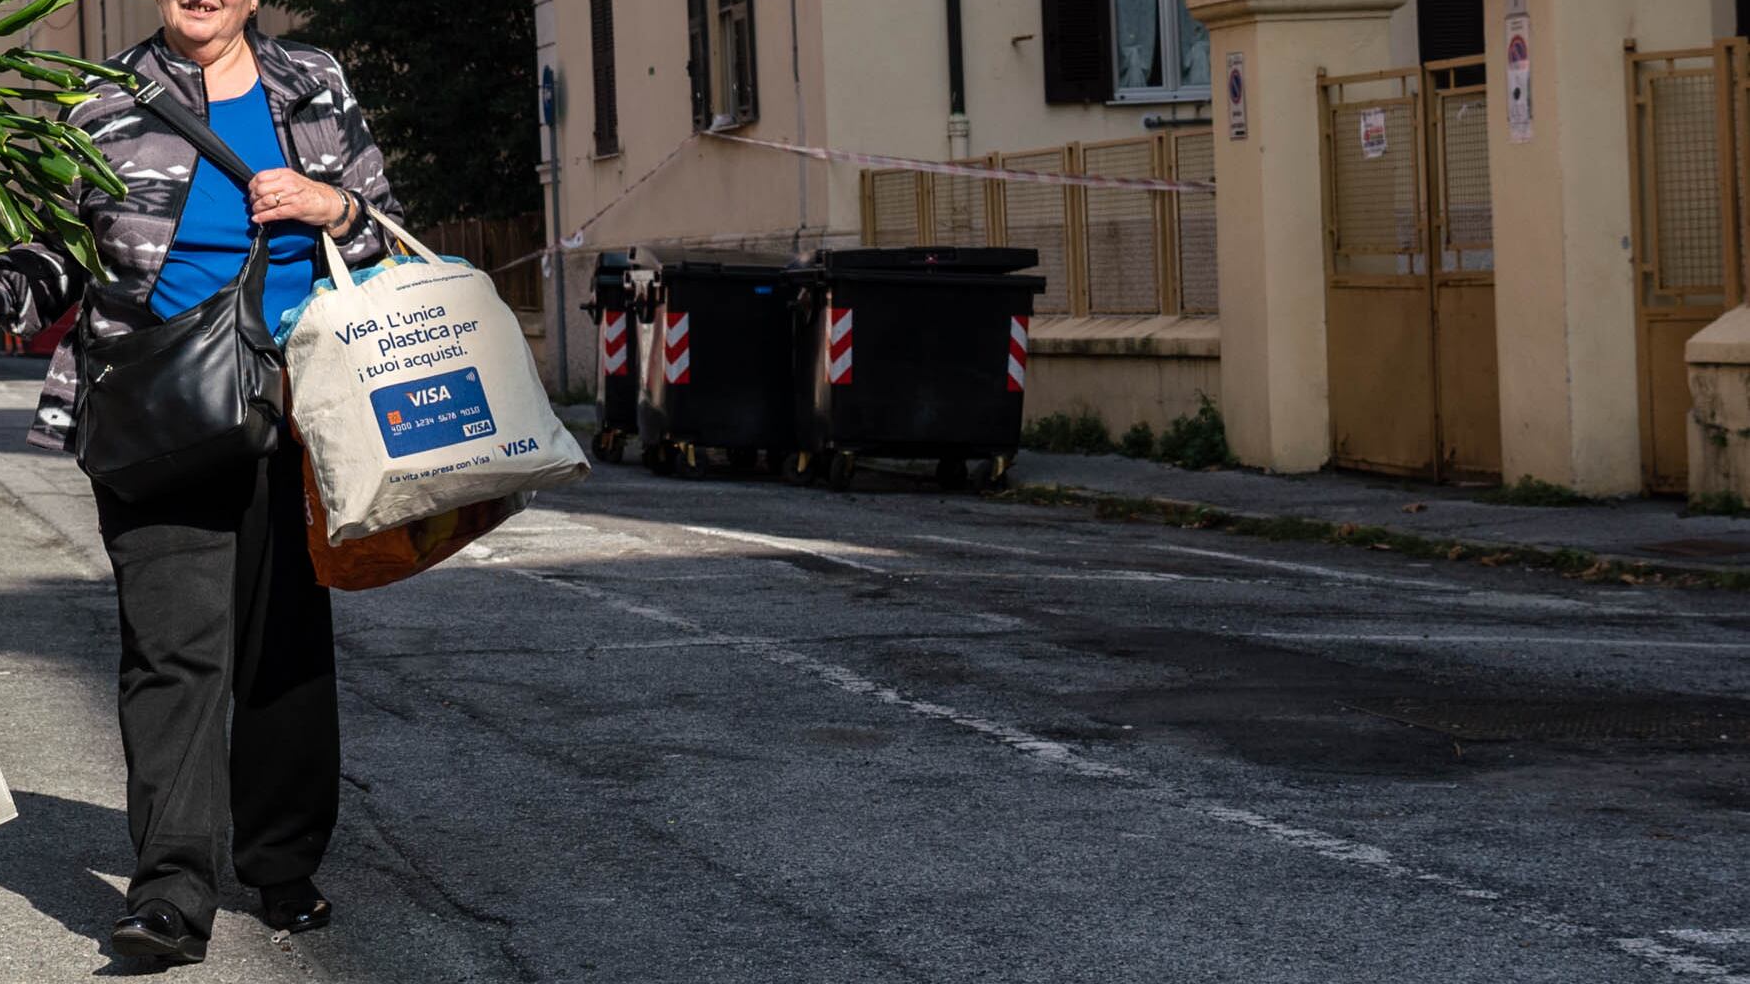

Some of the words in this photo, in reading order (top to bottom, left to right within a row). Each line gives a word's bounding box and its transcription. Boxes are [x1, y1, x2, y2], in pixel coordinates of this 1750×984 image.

[335, 319, 384, 345] Visa.
[386, 305, 446, 328] L'unica
[378, 323, 450, 357] plastica
[453, 319, 479, 339] per
[358, 368, 364, 383] i
[366, 355, 400, 378] tuoi
[404, 341, 468, 368] acquisti.
[406, 385, 451, 407] VISA
[391, 422, 412, 432] 4000
[416, 417, 435, 428] 1234
[466, 421, 491, 435] VISA
[498, 437, 539, 457] VISA
[390, 474, 401, 484] La
[403, 472, 419, 482] vita
[420, 469, 430, 477] va
[431, 465, 454, 478] presa
[456, 461, 472, 470] con
[473, 455, 491, 466] Visa
